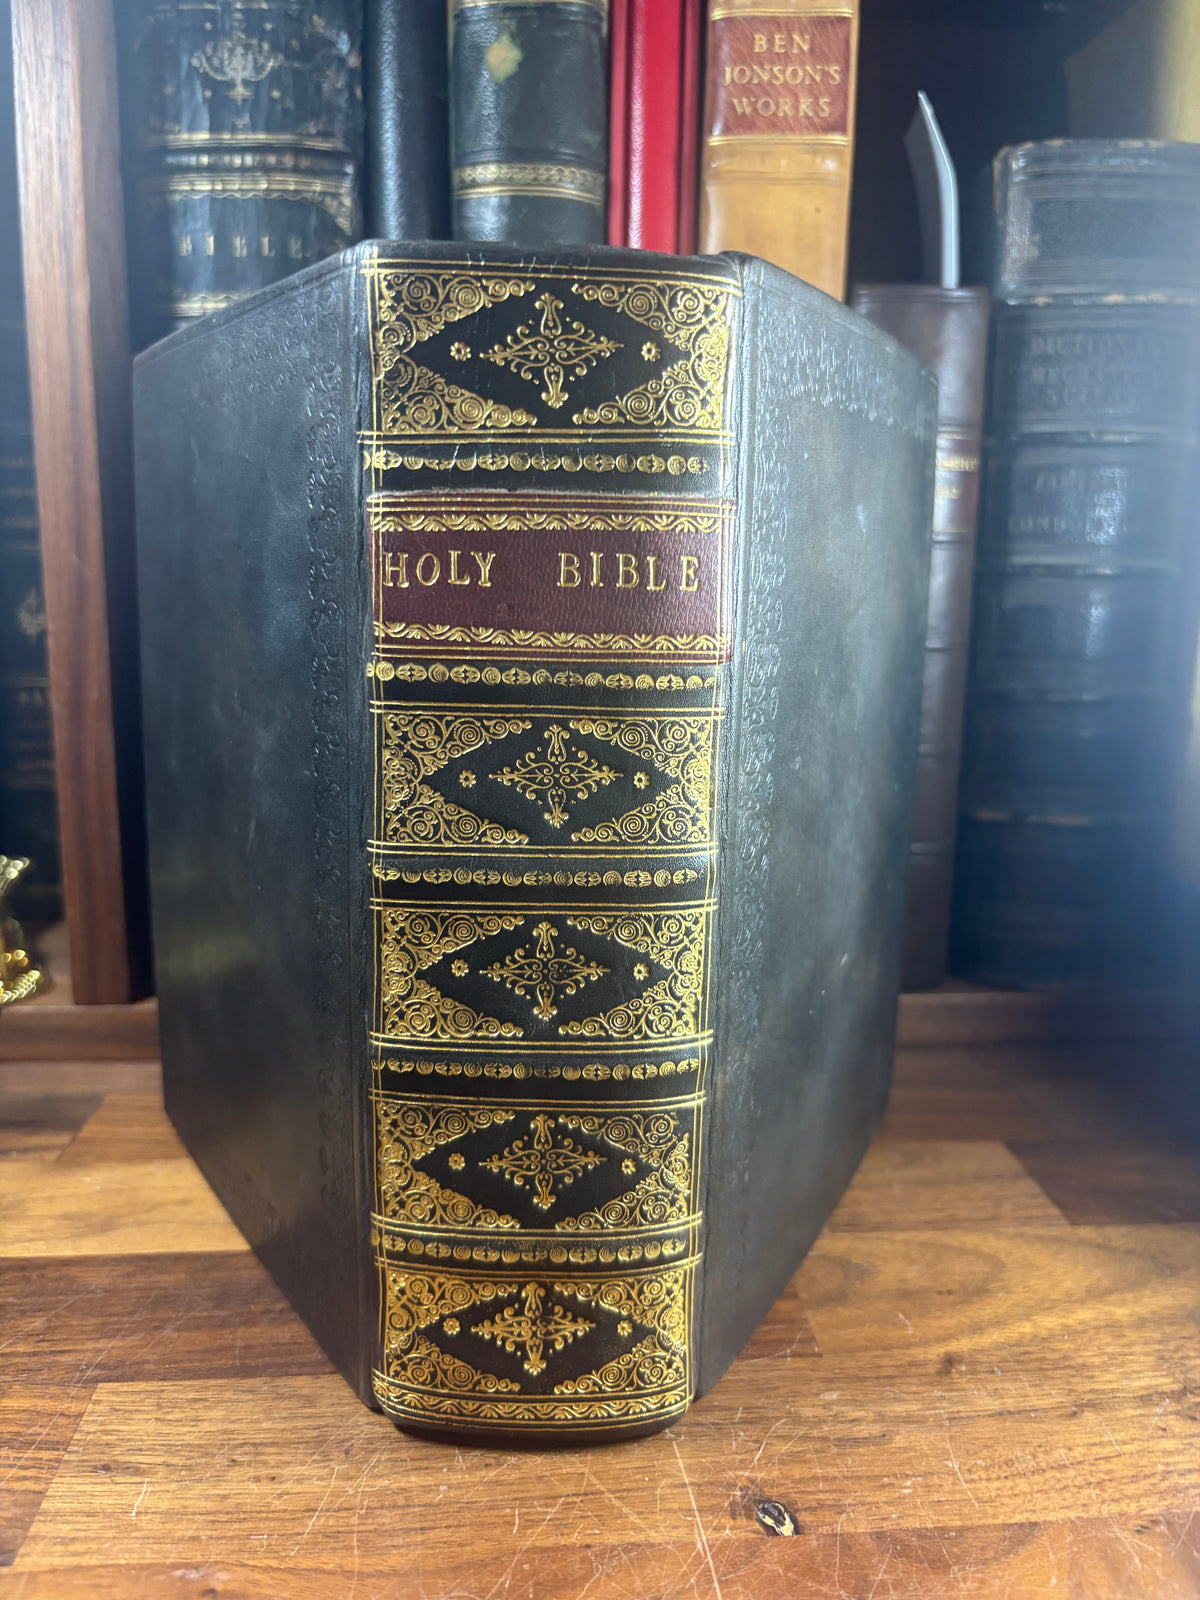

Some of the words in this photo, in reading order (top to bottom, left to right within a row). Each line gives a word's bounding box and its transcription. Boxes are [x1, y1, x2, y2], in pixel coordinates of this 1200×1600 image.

[753, 33, 811, 53] BEN
[723, 65, 841, 86] JONSON'S
[732, 97, 832, 118] WORKS
[383, 550, 497, 589] HOLY
[557, 551, 700, 593] BIBLE
